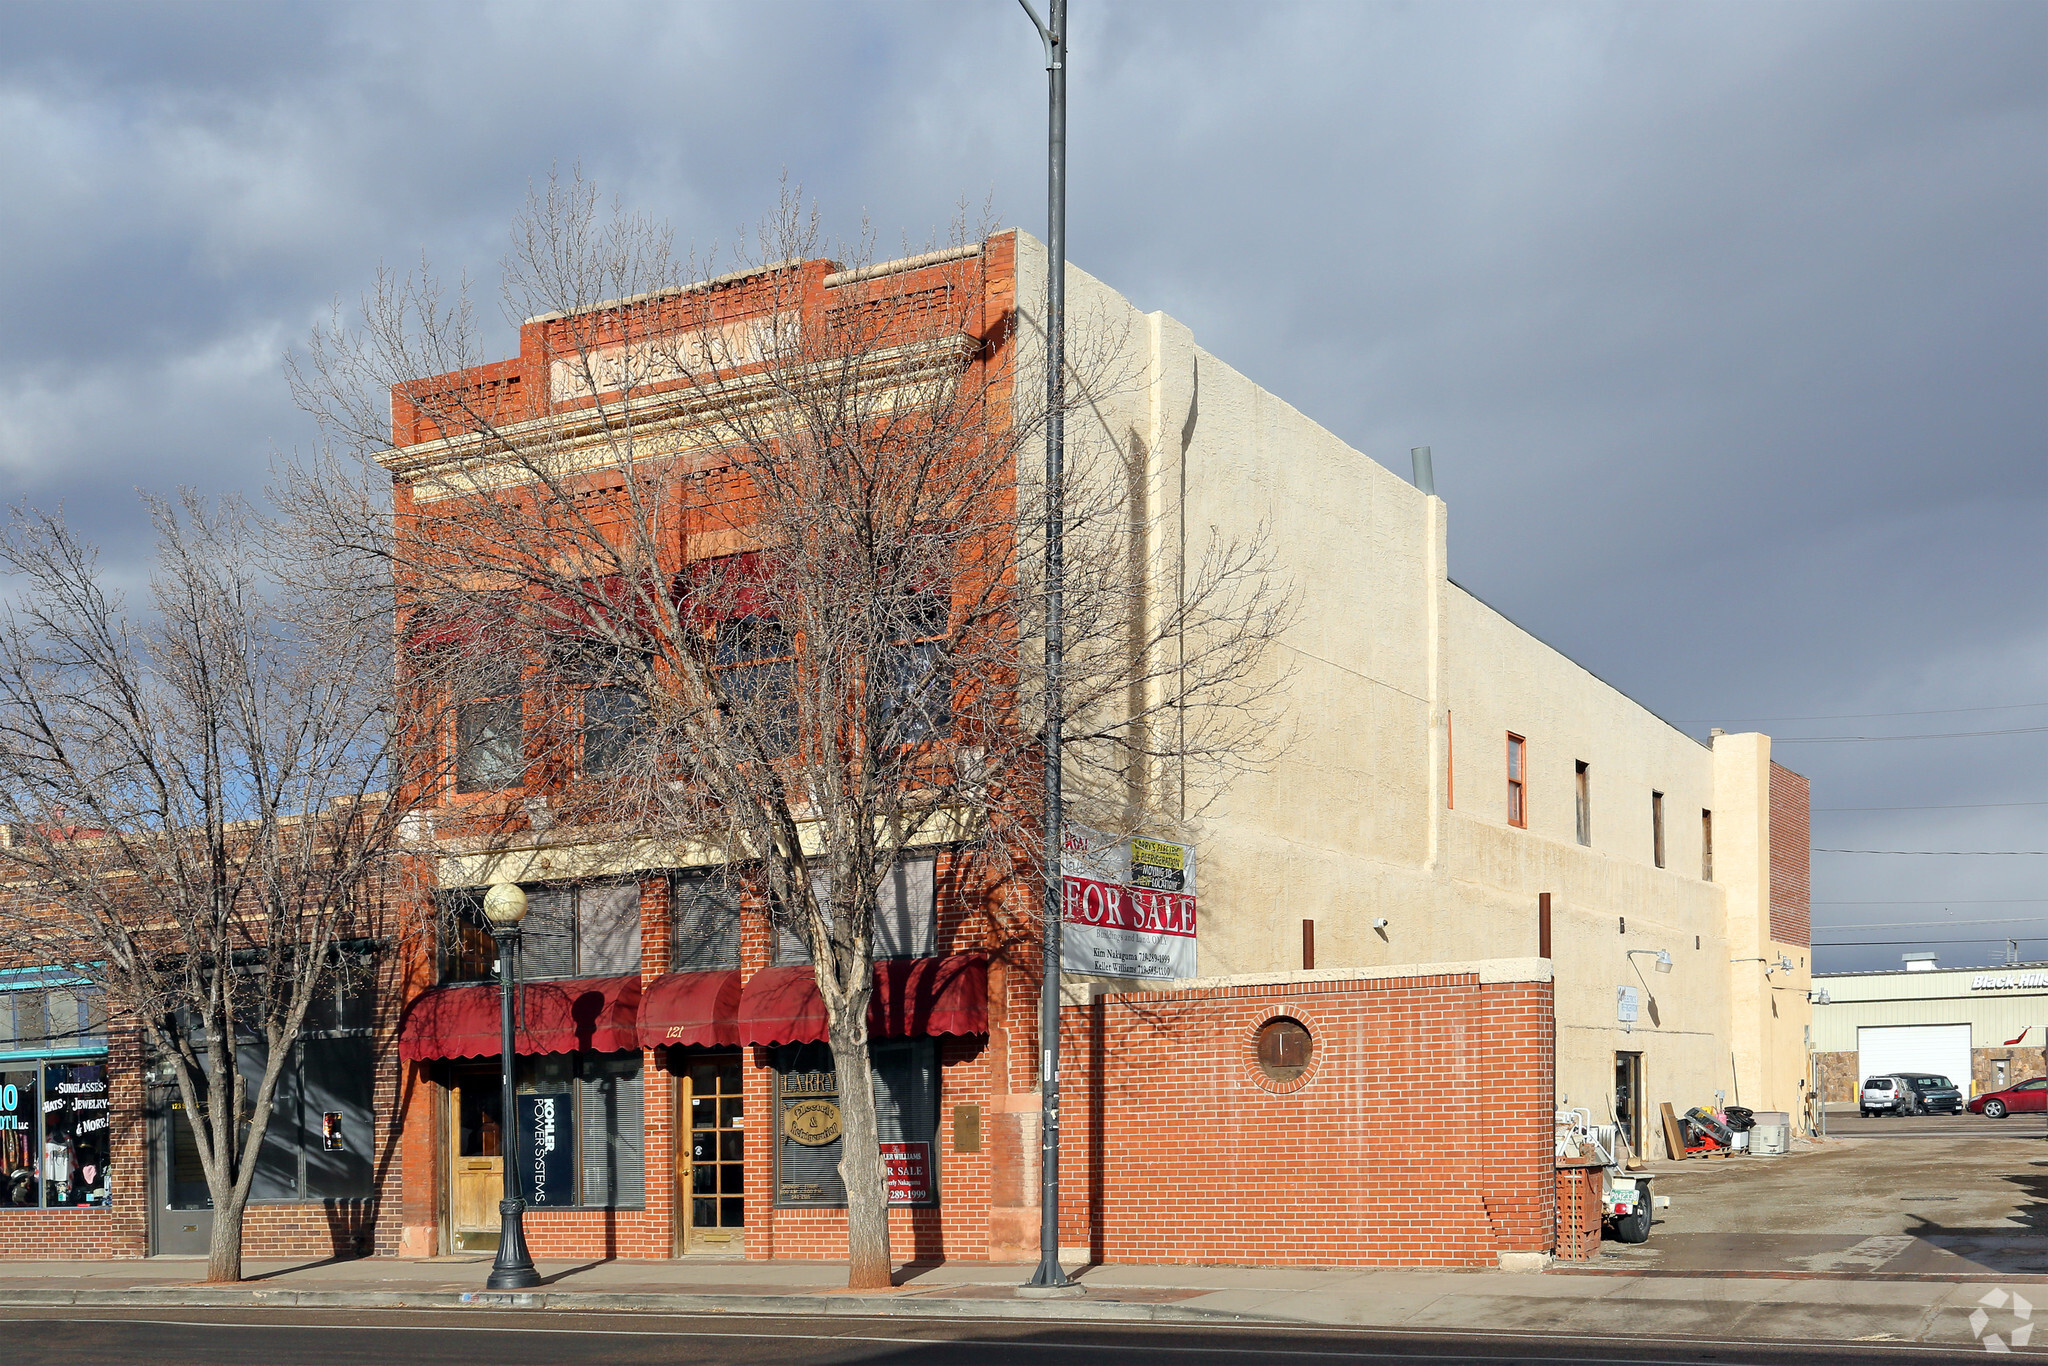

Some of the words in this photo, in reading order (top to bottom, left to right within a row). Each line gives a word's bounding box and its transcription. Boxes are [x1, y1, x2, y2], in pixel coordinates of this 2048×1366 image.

[1064, 880, 1125, 926] FOR
[1132, 891, 1196, 935] SALE
[1096, 928, 1123, 943] Buildings
[1125, 933, 1134, 942] and
[1093, 947, 1106, 958] Kim
[1107, 949, 1138, 962] Nakaguma
[1094, 960, 1112, 971] Keller
[1113, 962, 1137, 973] Williams
[1972, 975, 2015, 989] Black
[665, 1025, 685, 1039] 121
[58, 1082, 104, 1094] SUNGLASSES
[44, 1098, 63, 1113] HATS
[72, 1097, 108, 1111] JEWELRY
[793, 1104, 835, 1120] Electric
[18, 1122, 29, 1130] LLC
[533, 1098, 545, 1146] POWER
[543, 1098, 555, 1152] KOHLER
[809, 1117, 818, 1128] &
[76, 1123, 82, 1136] &
[790, 1120, 839, 1142] Refrigeration
[894, 1152, 922, 1160] WILLIAMS
[897, 1166, 923, 1176] SALE
[888, 1190, 926, 1199] -289-1999
